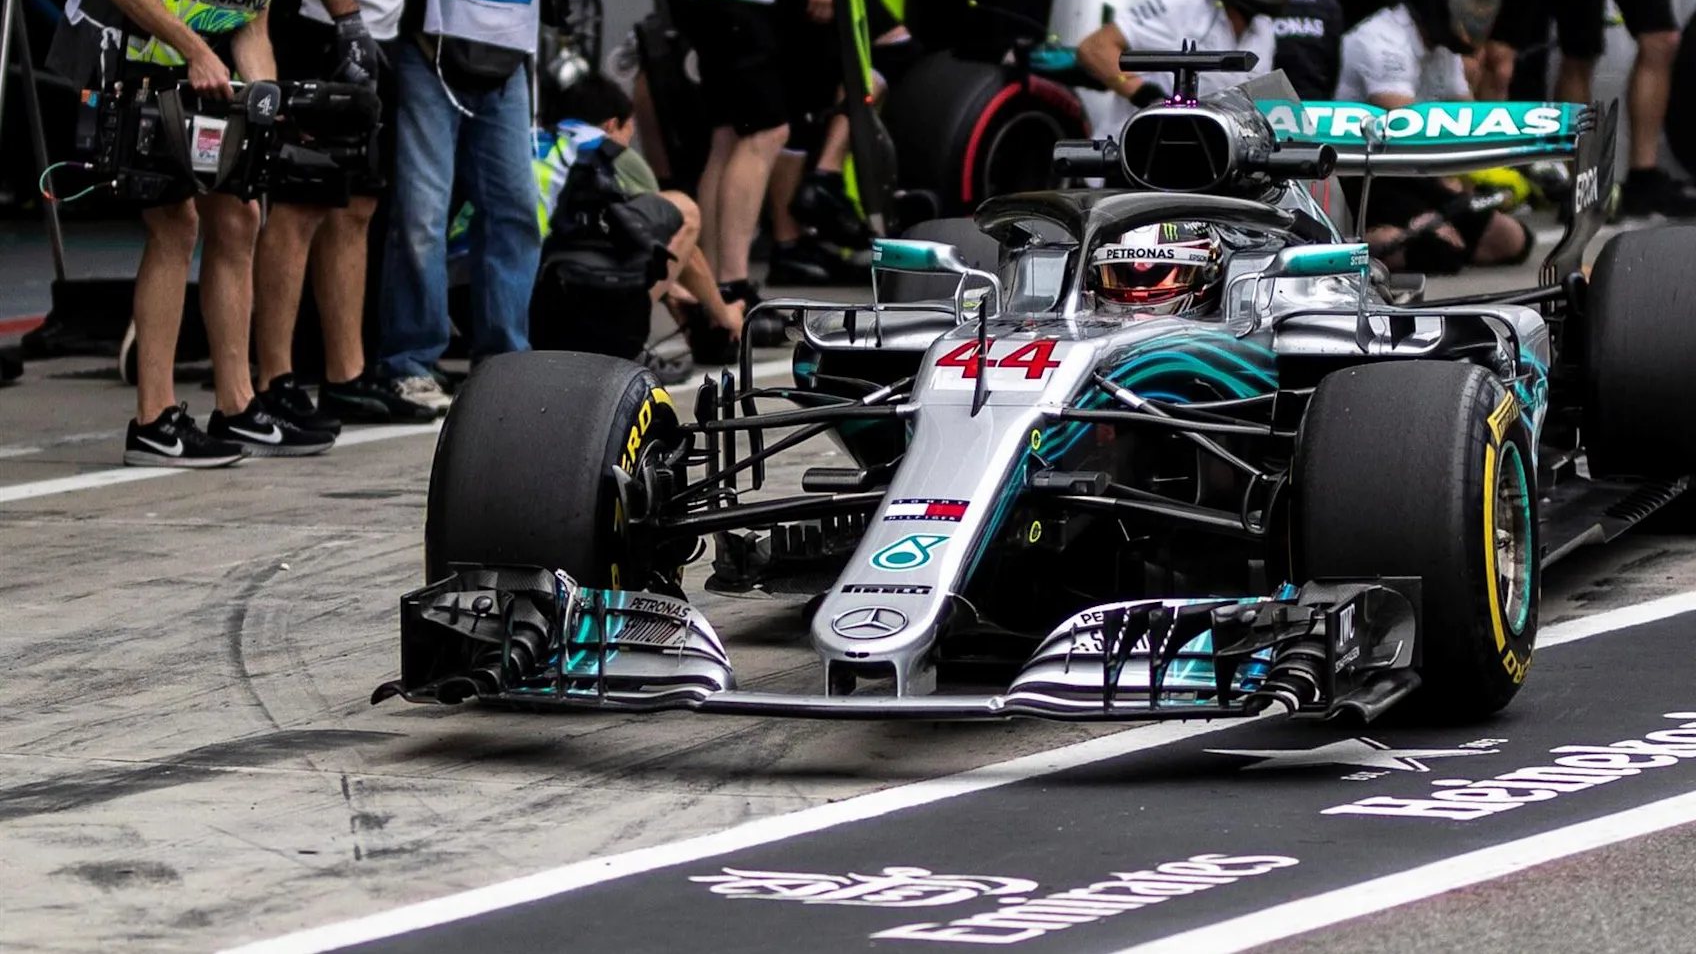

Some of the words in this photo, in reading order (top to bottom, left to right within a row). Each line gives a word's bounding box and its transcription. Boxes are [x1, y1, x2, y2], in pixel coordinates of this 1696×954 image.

[1106, 248, 1175, 259] PETRONAS
[935, 339, 1062, 380] 44
[629, 597, 692, 618] PETRONAS
[870, 853, 1299, 944] Emirates
